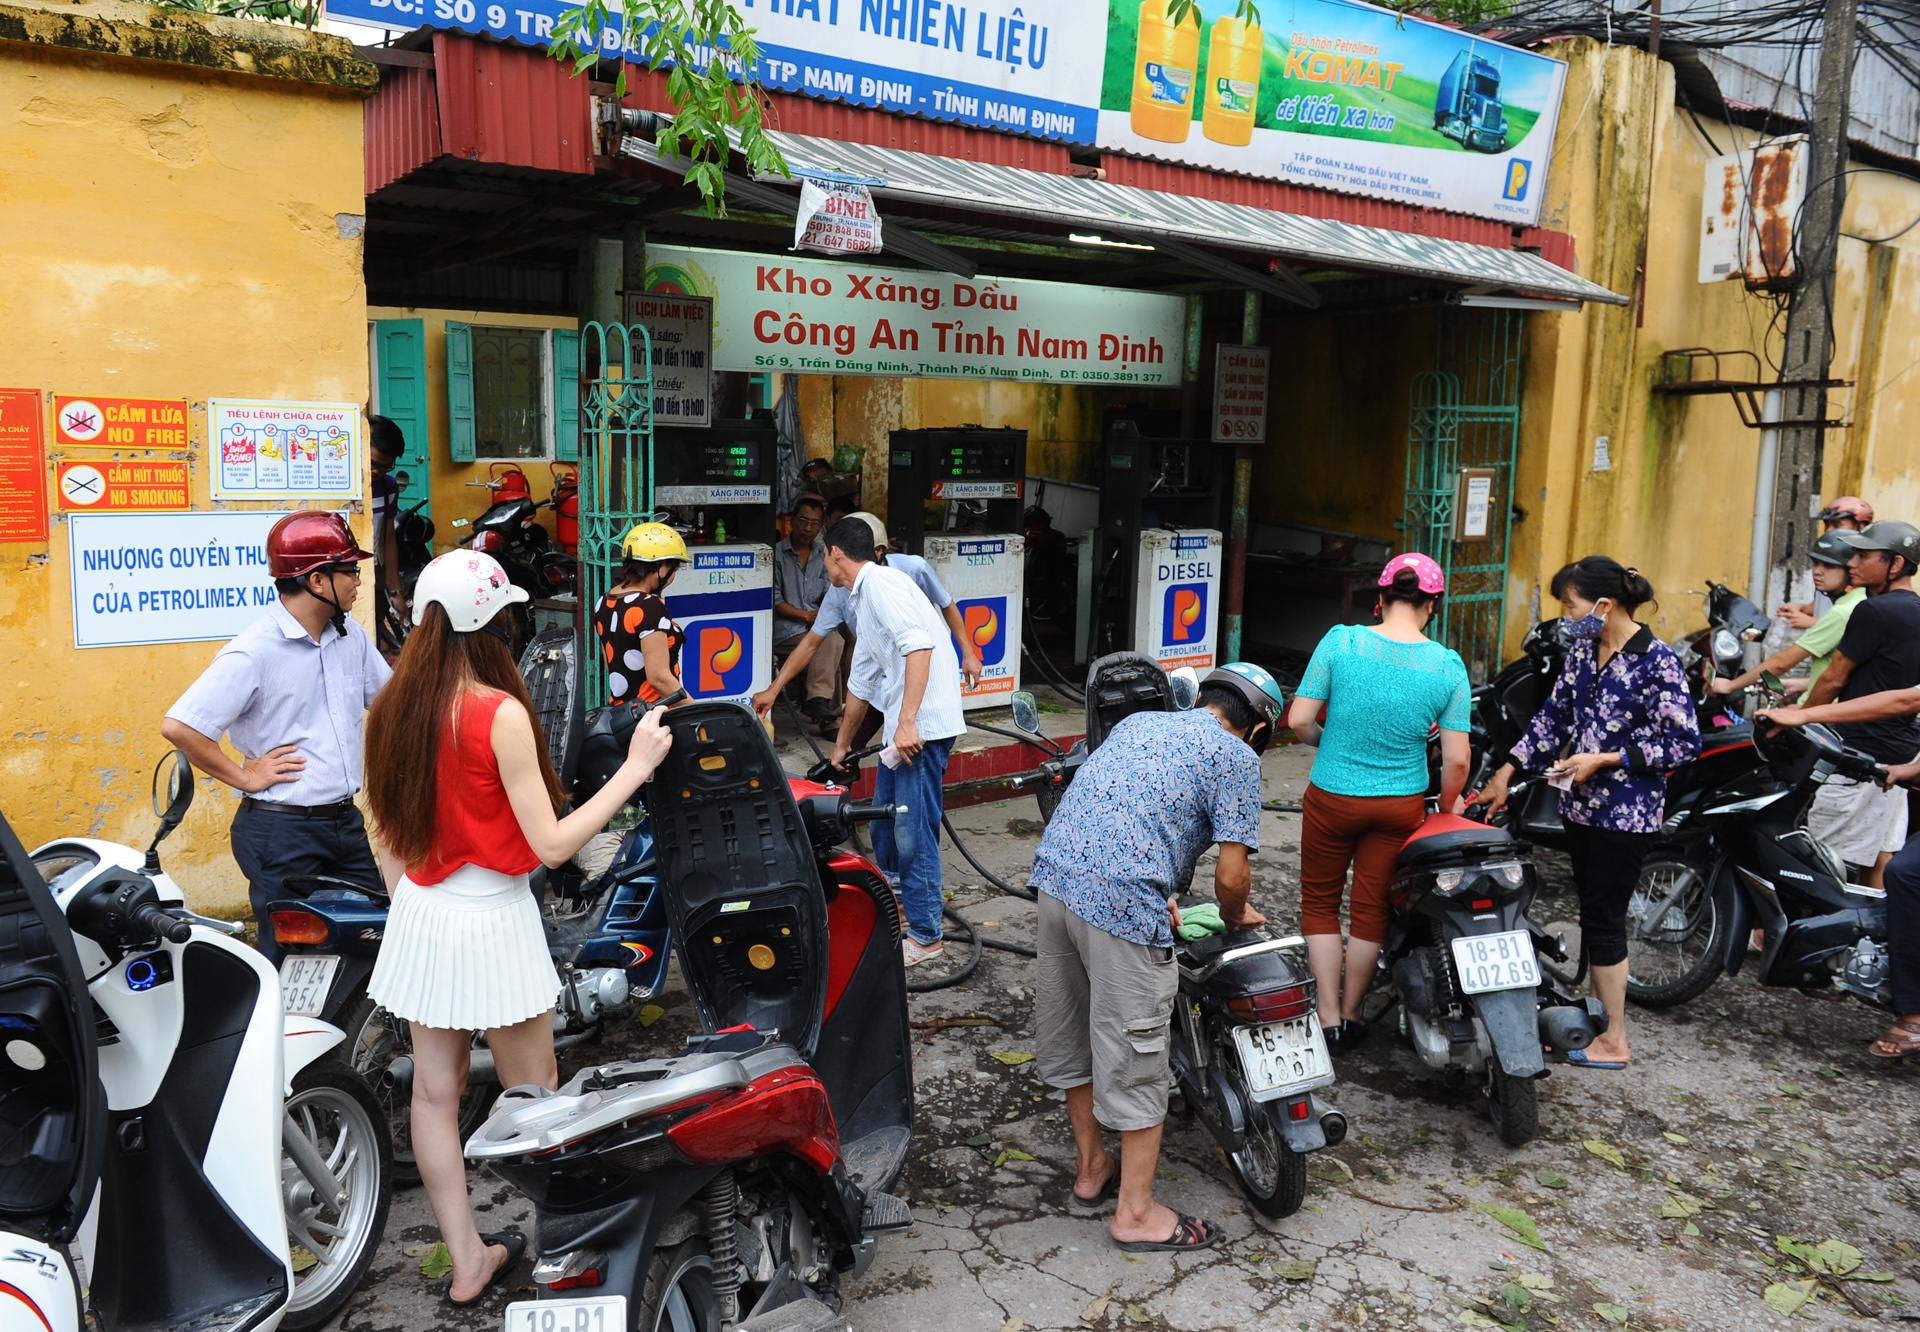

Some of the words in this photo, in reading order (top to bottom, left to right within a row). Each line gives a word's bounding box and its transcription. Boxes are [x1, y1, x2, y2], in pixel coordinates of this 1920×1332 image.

[977, 7, 1048, 74] LIỆU
[1334, 38, 1379, 56] Petrolimex
[487, 5, 506, 29] 9
[766, 58, 798, 83] TP
[804, 66, 853, 94] NAM
[860, 77, 912, 105] ĐỊNH
[932, 86, 978, 117] TỈNH
[984, 100, 1026, 126] NAM
[1031, 112, 1076, 135] ĐỊNH
[1283, 49, 1404, 90] KOMAT
[1300, 95, 1339, 124] tiến
[1342, 107, 1368, 126] xa
[1369, 110, 1395, 130] hơn
[1294, 152, 1313, 163] TẬP
[1315, 155, 1340, 168] ĐOÀN
[1342, 160, 1367, 174] XĂNG
[1368, 165, 1387, 177] DẦU
[1388, 170, 1409, 183] VIỆT
[1410, 175, 1428, 185] NAM
[1281, 161, 1306, 175] TỔNG
[1308, 166, 1334, 180] CÔNG
[1336, 173, 1347, 182] TY
[1350, 174, 1367, 186] HÓA
[1369, 177, 1388, 190] DẦU
[1390, 183, 1442, 200] PETROLIMEX
[1493, 203, 1530, 215] PETROLIMEX
[835, 226, 852, 235] 848
[854, 229, 872, 239] 650
[824, 235, 844, 246] 647
[846, 238, 871, 252] 6682
[756, 265, 832, 296] Kho
[846, 274, 940, 311] Xăng
[953, 278, 1018, 312] Dầu
[635, 301, 657, 318] LỊCH
[660, 301, 680, 319] LÀM
[683, 303, 704, 322] VIỆC
[657, 328, 684, 341] sáng:
[753, 310, 855, 355] Công
[869, 318, 919, 351] An
[931, 320, 1004, 356] Tỉnh
[1017, 328, 1088, 360] Nam
[1098, 333, 1164, 370] Định
[665, 346, 679, 367] đến
[681, 349, 704, 368] 11h00
[755, 354, 776, 366] Số
[779, 355, 794, 368] 9,
[798, 356, 831, 369] Trần
[835, 359, 873, 372] Đăng
[877, 361, 913, 373] Ninh,
[917, 362, 958, 374] Thành
[962, 365, 986, 375] Phố
[990, 366, 1018, 377] Nam
[1022, 368, 1053, 380] Định,
[1060, 369, 1079, 379] ĐT:
[1082, 370, 1139, 381] 0350.3891
[1143, 373, 1162, 382] 377
[105, 402, 147, 423] CẤM
[151, 404, 184, 424] LỬA
[226, 408, 250, 419] TIÊU
[253, 410, 280, 421] LỆNH
[283, 411, 313, 420] CHỮA
[316, 412, 344, 421] CHÁY
[682, 398, 704, 417] 18h00
[8, 424, 30, 433] CHÁY
[107, 427, 135, 443] NO
[145, 428, 185, 445] FIRE
[267, 426, 275, 434] 2
[228, 444, 246, 453] BÁO
[225, 453, 252, 463] ĐỘNG
[108, 464, 133, 483] CẤM
[133, 466, 152, 483] HÚT
[154, 465, 185, 483] THUỐC
[110, 489, 127, 505] NO
[130, 489, 185, 505] SMOKING
[710, 488, 732, 497] XĂNG
[931, 480, 944, 500] 2
[955, 485, 973, 493] XĂNG
[83, 546, 163, 576] NHƯỢNG
[169, 537, 230, 567] QUYỀN
[961, 543, 978, 553] XĂNG
[981, 544, 994, 552] RON
[994, 543, 1002, 552] 92
[698, 555, 719, 566] XĂNG
[724, 556, 740, 566] RON
[742, 555, 751, 566] 95
[966, 554, 996, 566] SEEN
[708, 570, 736, 585] EEN
[1158, 562, 1213, 581] DIESEL
[92, 582, 132, 614] CỦA
[138, 586, 247, 612] PETROLIMEX
[253, 585, 276, 606] NA
[1159, 645, 1207, 658] PETROLIMEX
[1779, 869, 1814, 882] HONDA
[1473, 913, 1497, 921] HONDA
[1466, 936, 1520, 963] 18-B1
[288, 960, 328, 984] 18-Z4
[1466, 960, 1535, 989] 402.69
